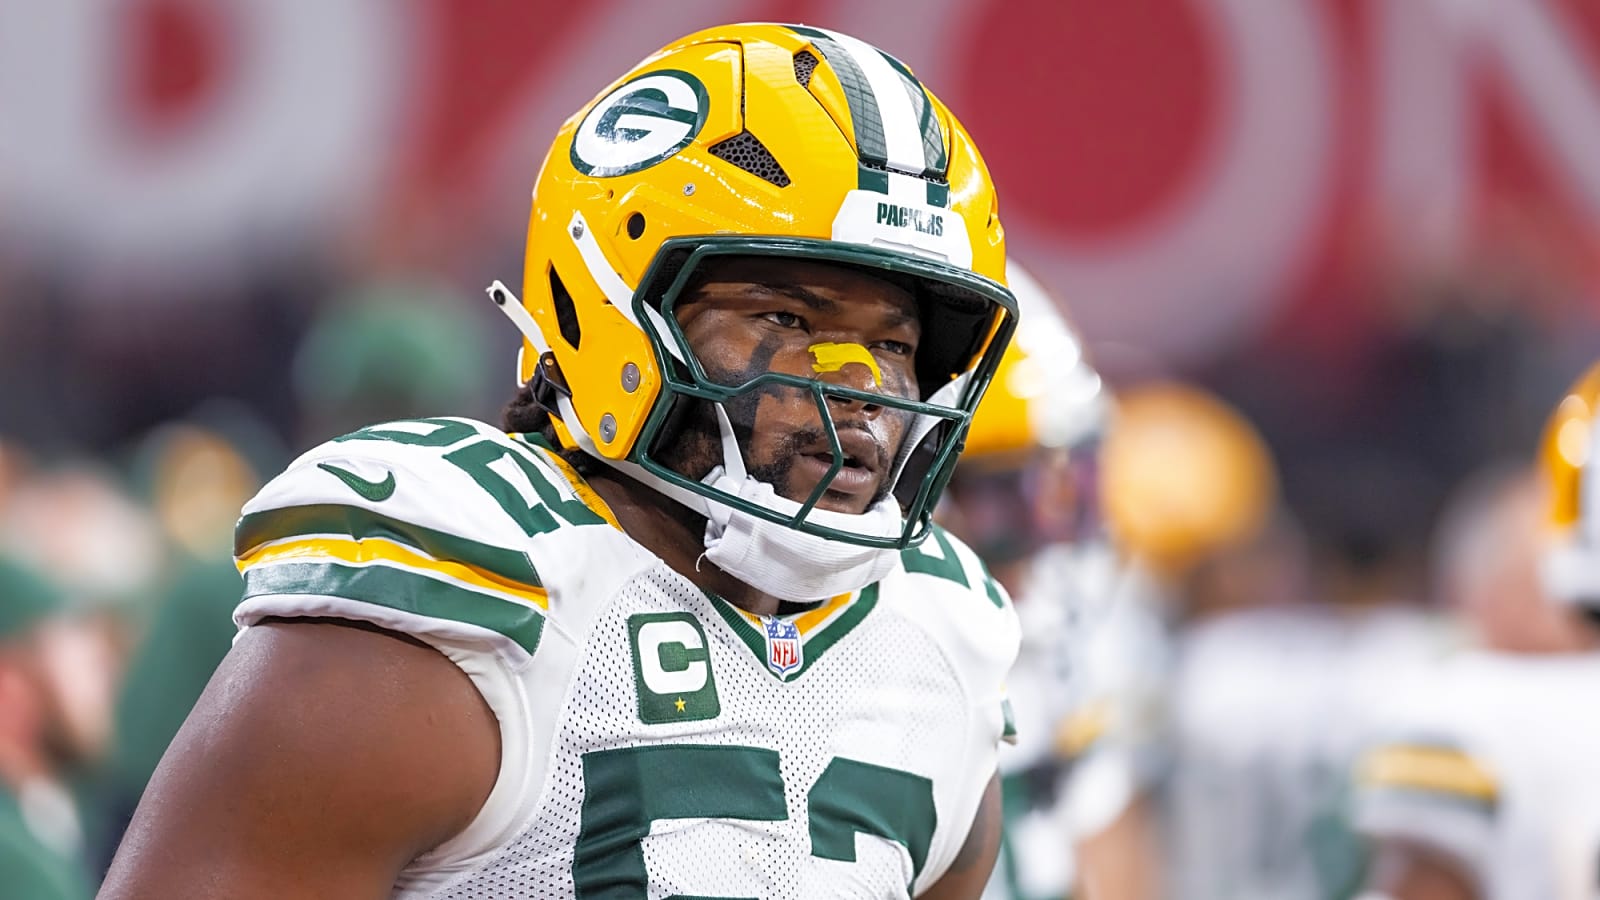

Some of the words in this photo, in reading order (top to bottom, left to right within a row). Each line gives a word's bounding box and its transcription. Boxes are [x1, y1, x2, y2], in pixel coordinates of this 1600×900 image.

[572, 72, 704, 172] G
[638, 620, 708, 695] C
[772, 640, 797, 668] NFL
